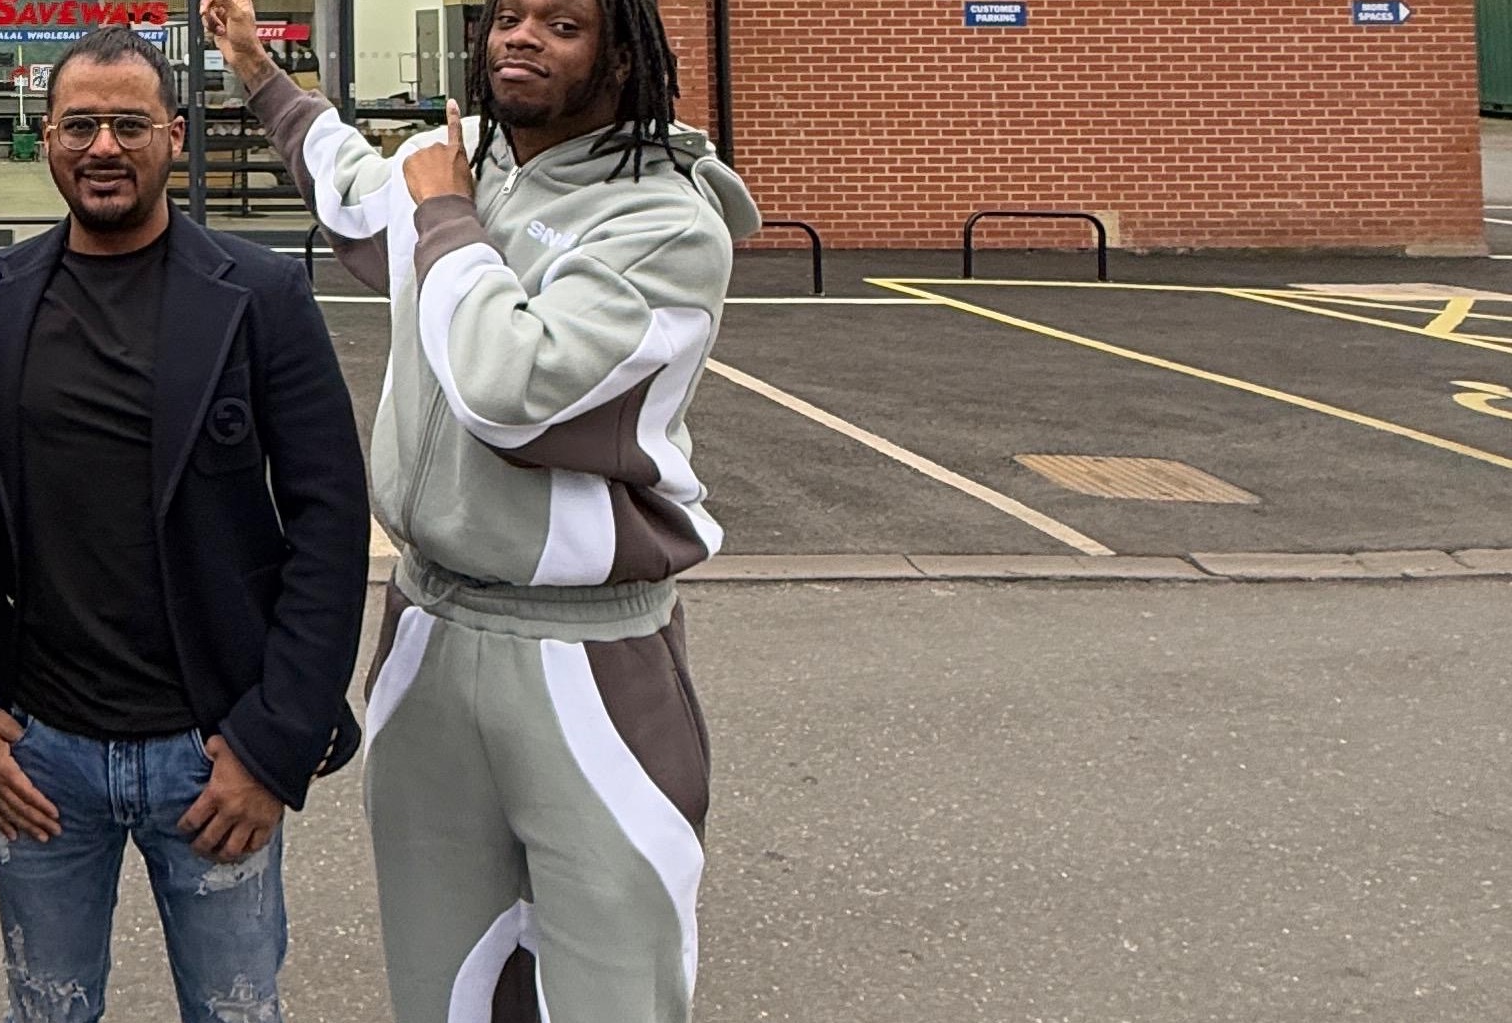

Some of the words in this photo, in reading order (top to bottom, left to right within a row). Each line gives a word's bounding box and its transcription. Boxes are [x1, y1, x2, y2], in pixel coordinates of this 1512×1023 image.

[970, 5, 1021, 14] CUSTOMER
[975, 14, 1017, 22] PARKING
[256, 27, 286, 37] EXIT
